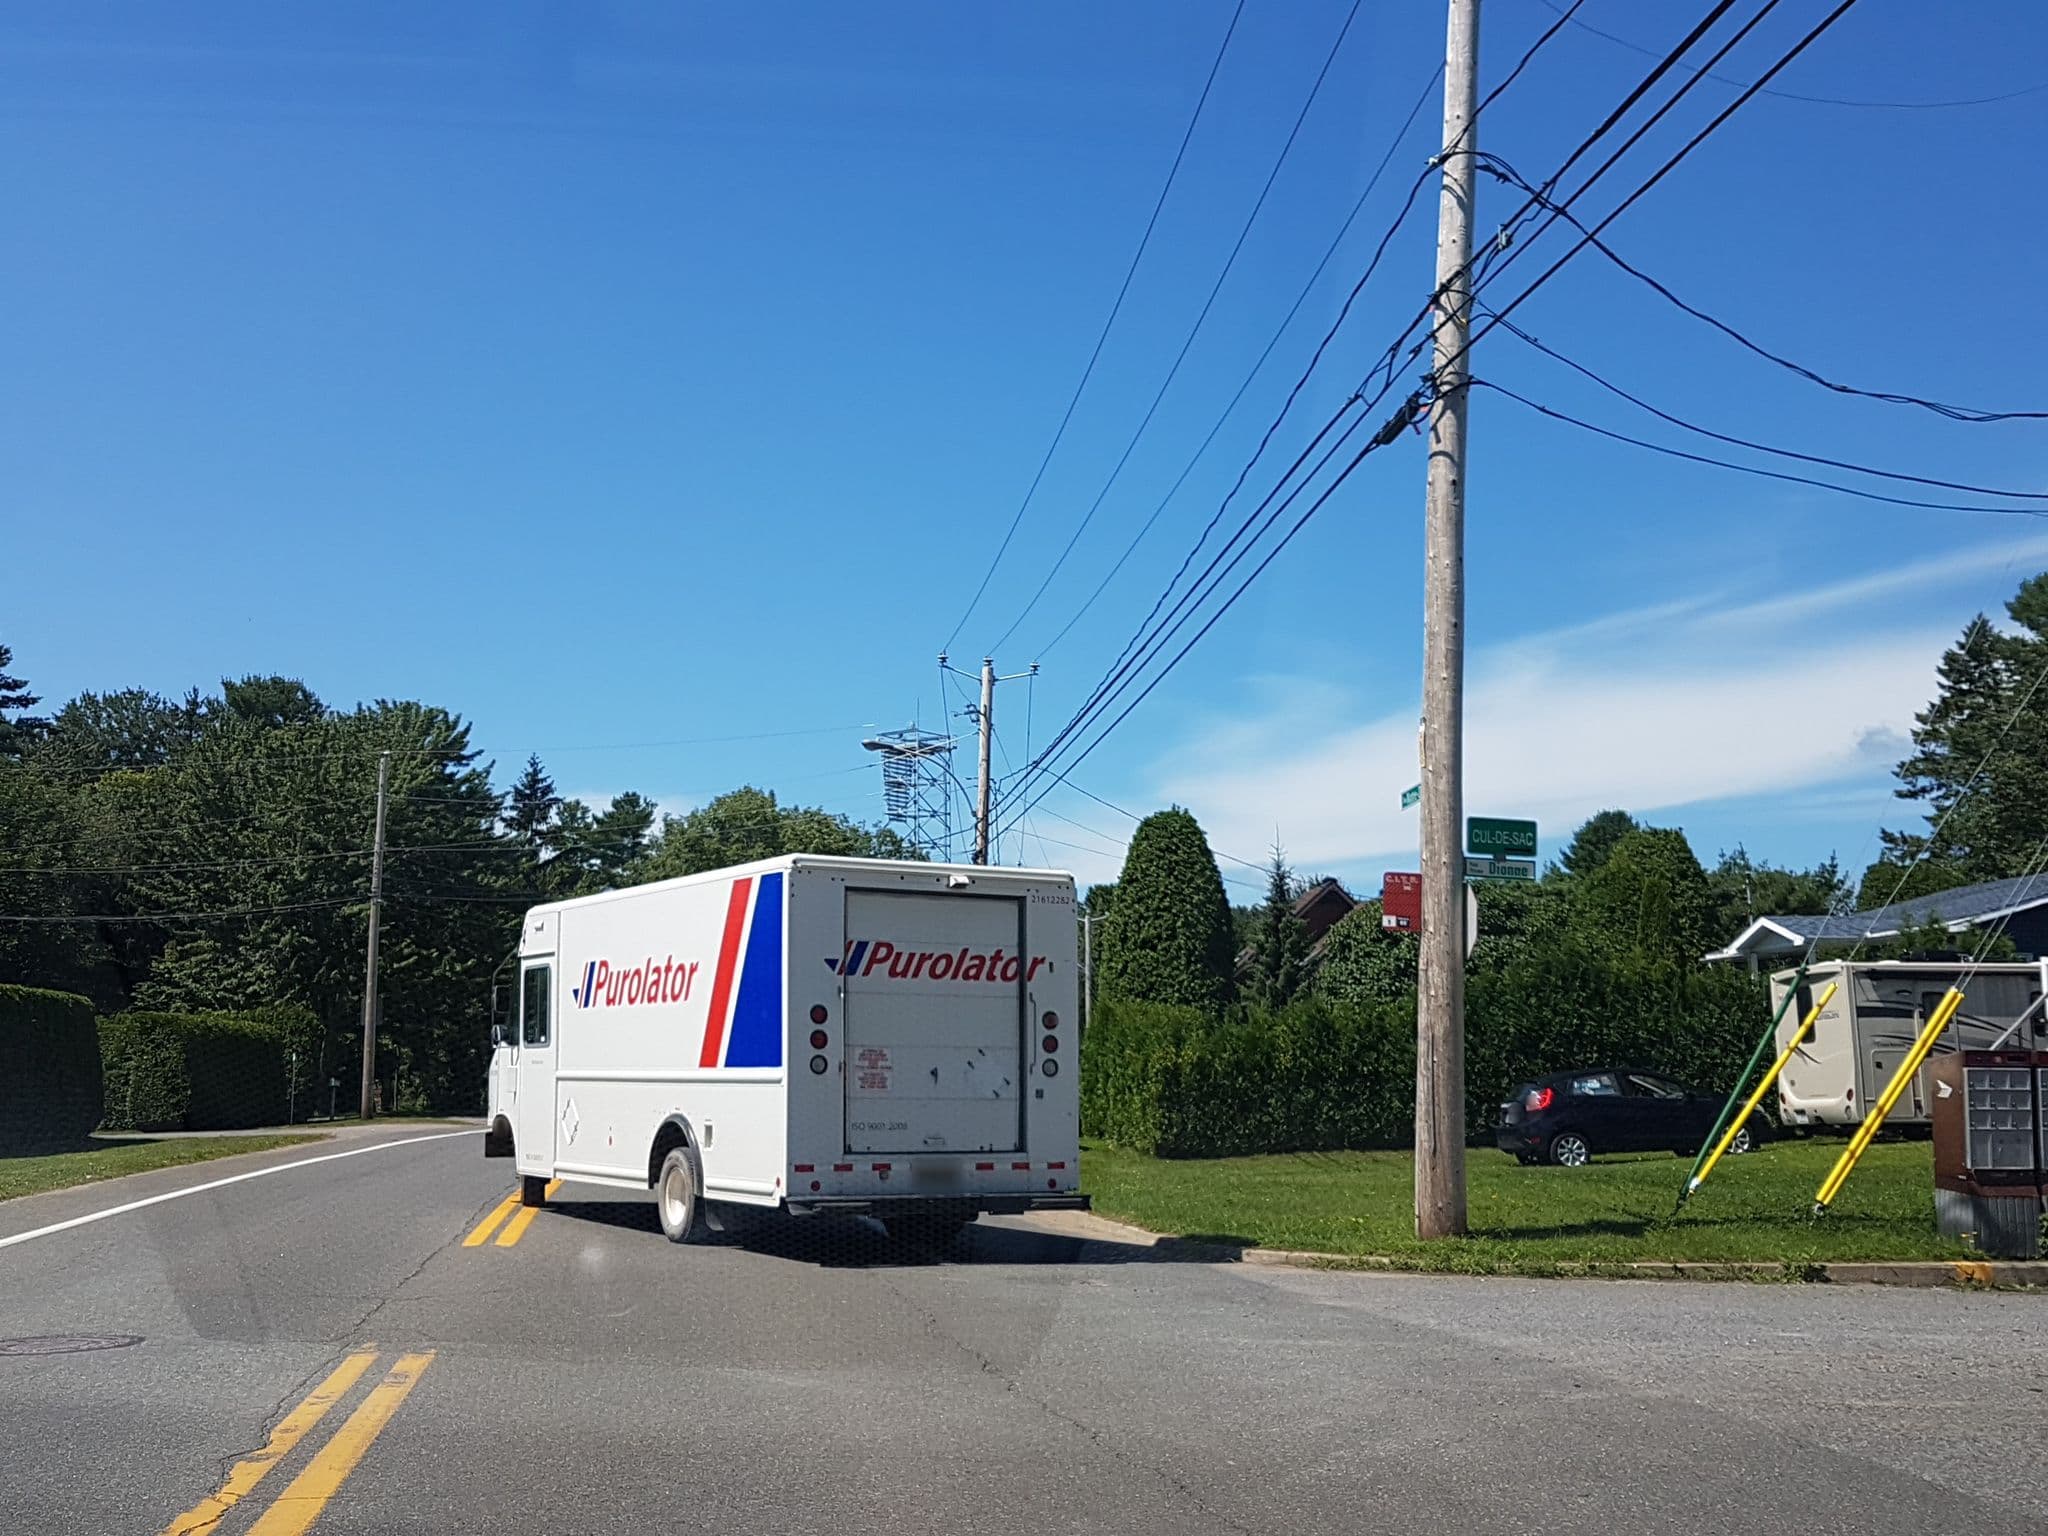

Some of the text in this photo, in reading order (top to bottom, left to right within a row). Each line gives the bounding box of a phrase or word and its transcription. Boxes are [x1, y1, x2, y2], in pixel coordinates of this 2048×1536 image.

[1472, 829, 1534, 847] CUL-DE-SAC
[1488, 861, 1529, 877] Dionne
[862, 940, 1046, 983] Purolator
[592, 954, 700, 1008] Purolator
[851, 1121, 866, 1131] ISO
